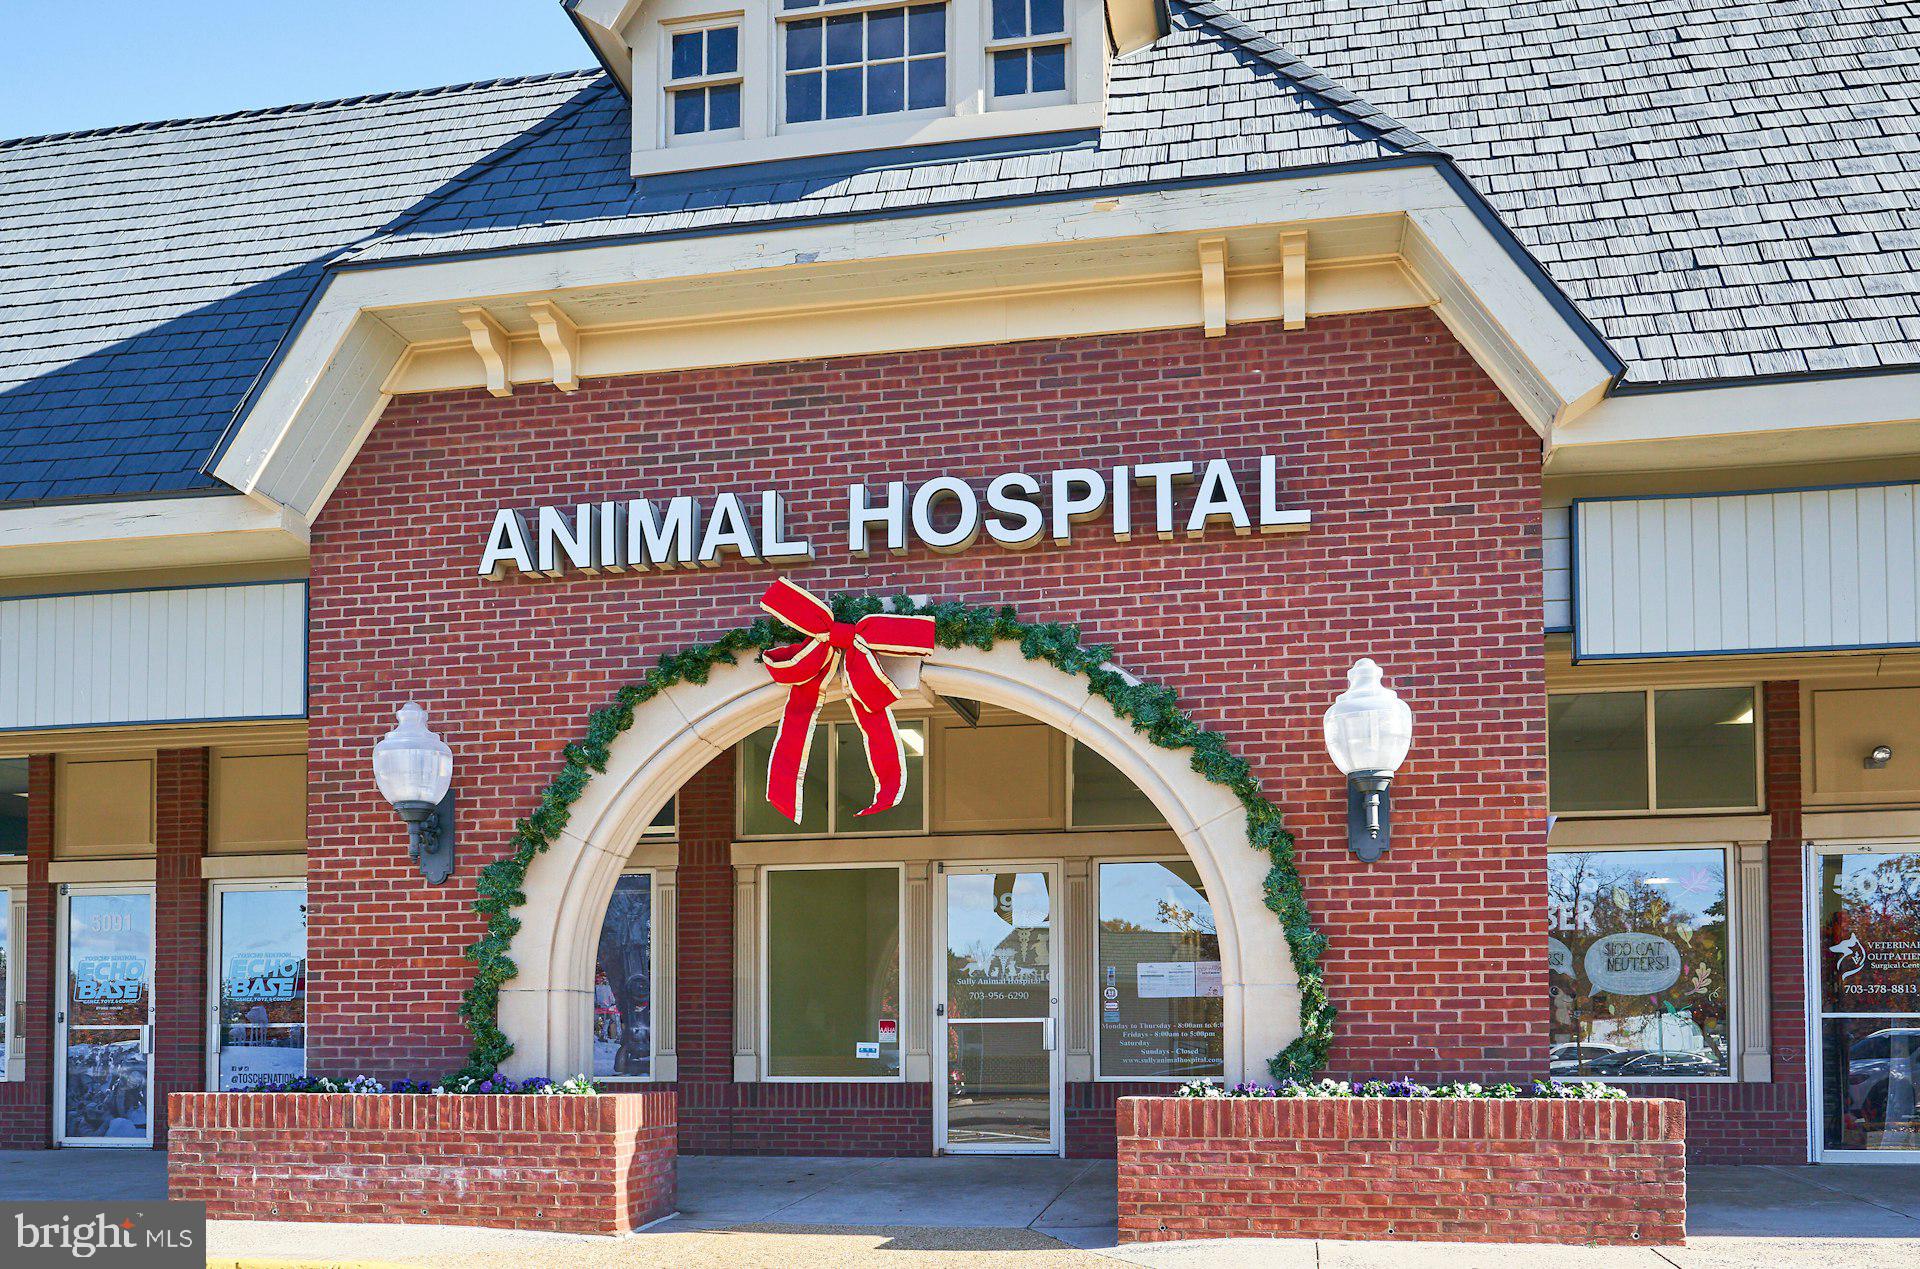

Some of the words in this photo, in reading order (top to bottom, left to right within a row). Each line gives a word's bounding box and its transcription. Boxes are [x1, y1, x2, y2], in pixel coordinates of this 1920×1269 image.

[478, 490, 812, 578] ANIMAL
[849, 455, 1311, 556] HOSPITAL
[90, 913, 132, 932] 5091
[1637, 942, 1664, 956] CAT
[231, 959, 297, 978] ECHO
[1607, 956, 1670, 971] NEUTERS!
[1871, 962, 1900, 970] Surgical
[79, 962, 144, 980] ECHO
[230, 978, 294, 997] BASE
[957, 978, 976, 986] Sully
[1008, 977, 1041, 986] Hospital
[78, 981, 139, 999] BASE
[968, 992, 1029, 1000] 703-956-6290
[1844, 985, 1917, 994] 703-378-8813
[1140, 1022, 1171, 1030] Thursday
[1122, 1031, 1149, 1039] Fridays
[231, 1073, 295, 1084] @TOSCHENATION
